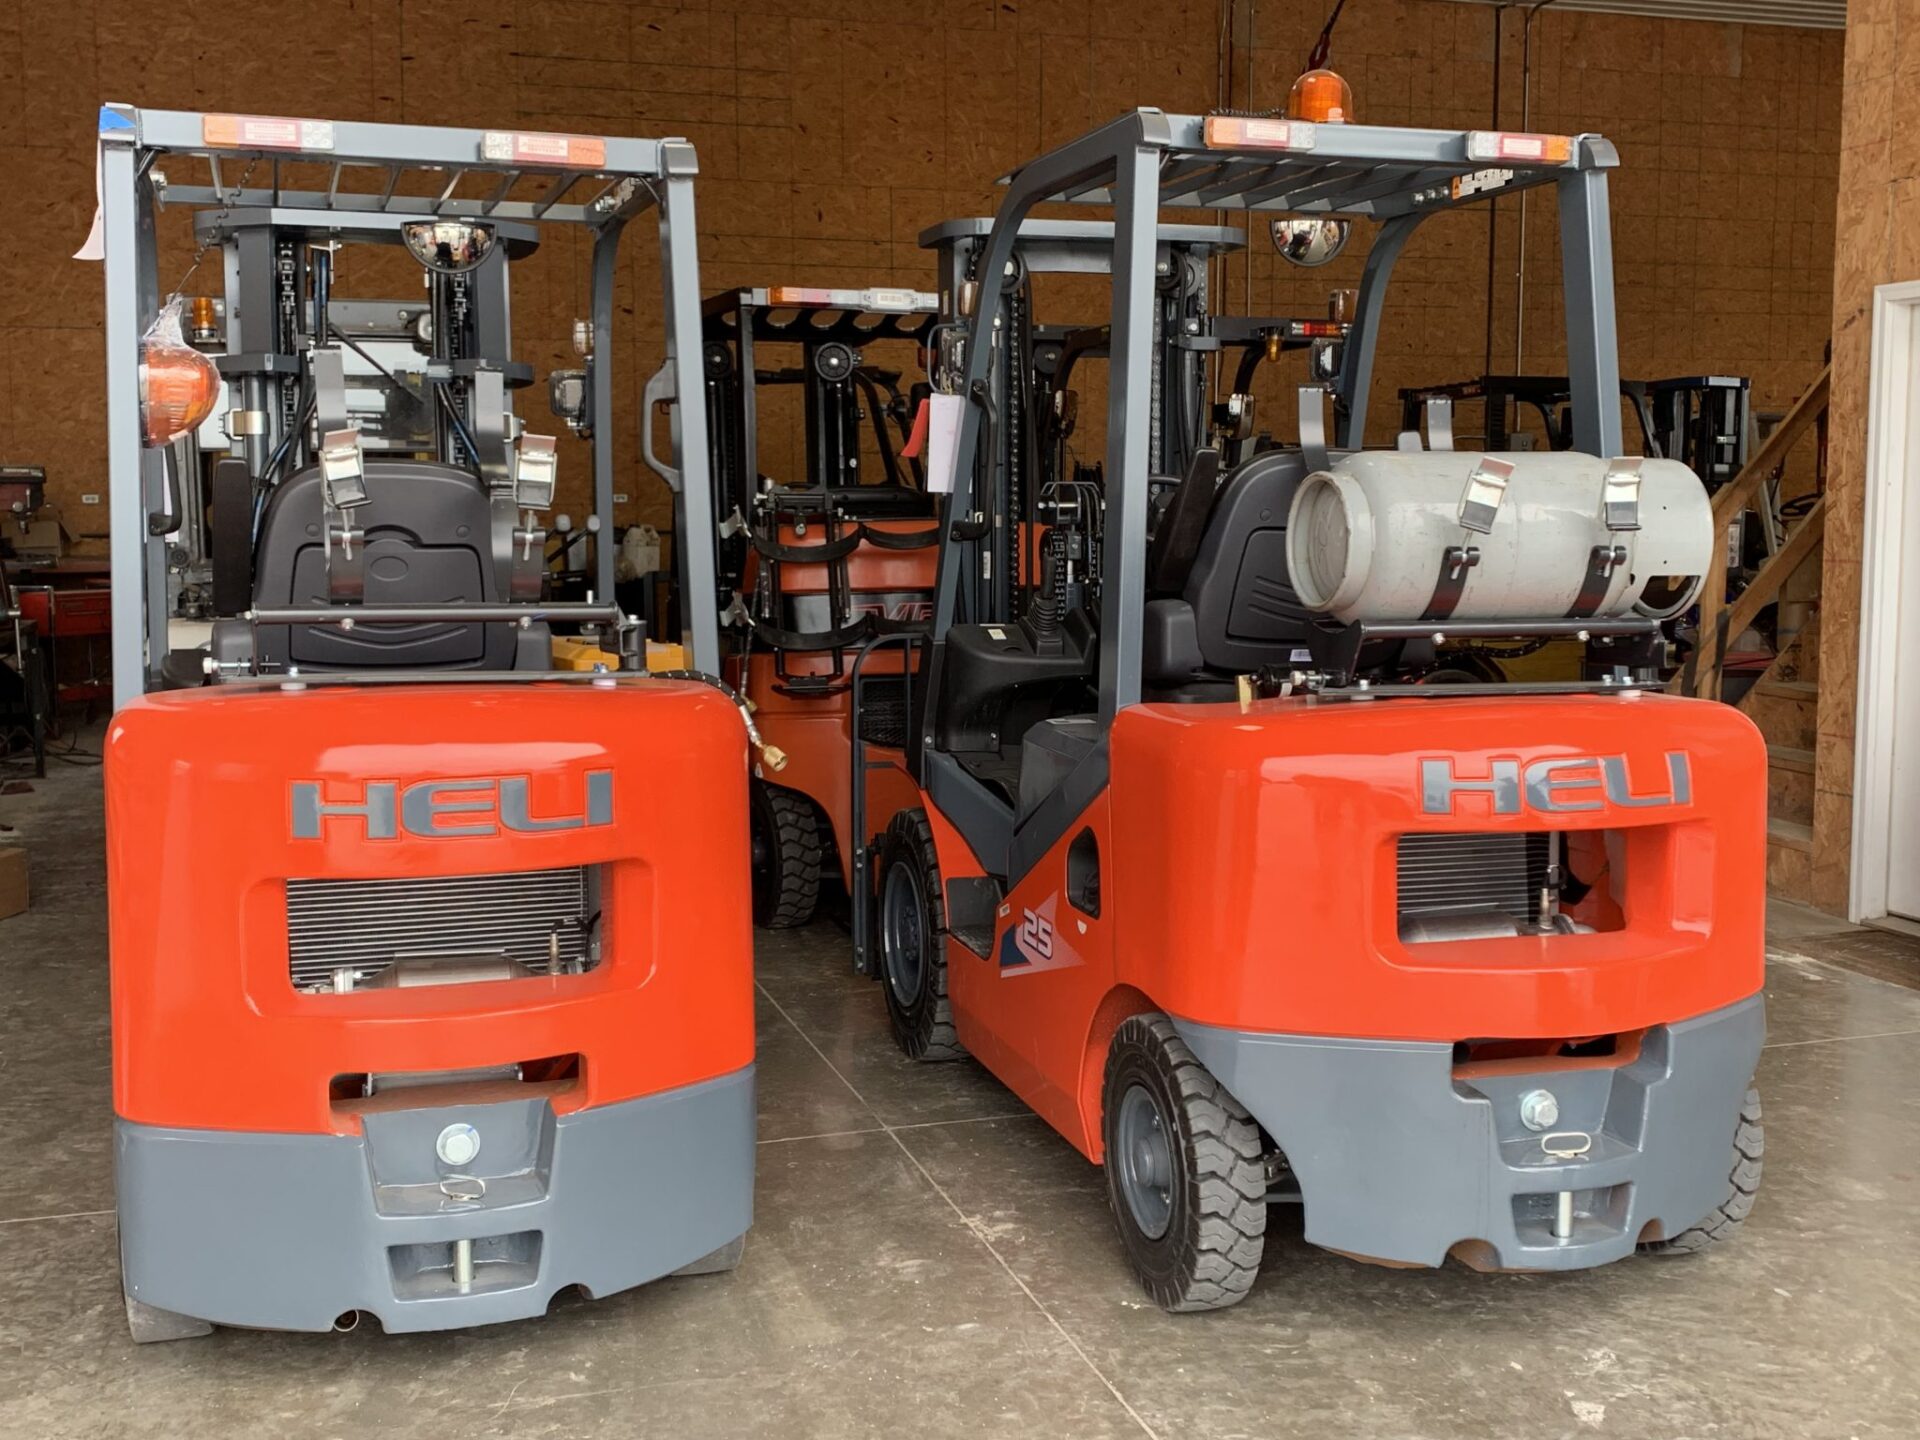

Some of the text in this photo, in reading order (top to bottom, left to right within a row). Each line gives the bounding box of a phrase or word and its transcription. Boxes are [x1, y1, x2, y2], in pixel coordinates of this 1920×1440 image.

[291, 770, 614, 840] HELI
[1420, 751, 1692, 814] HELI
[1023, 907, 1053, 960] 25
